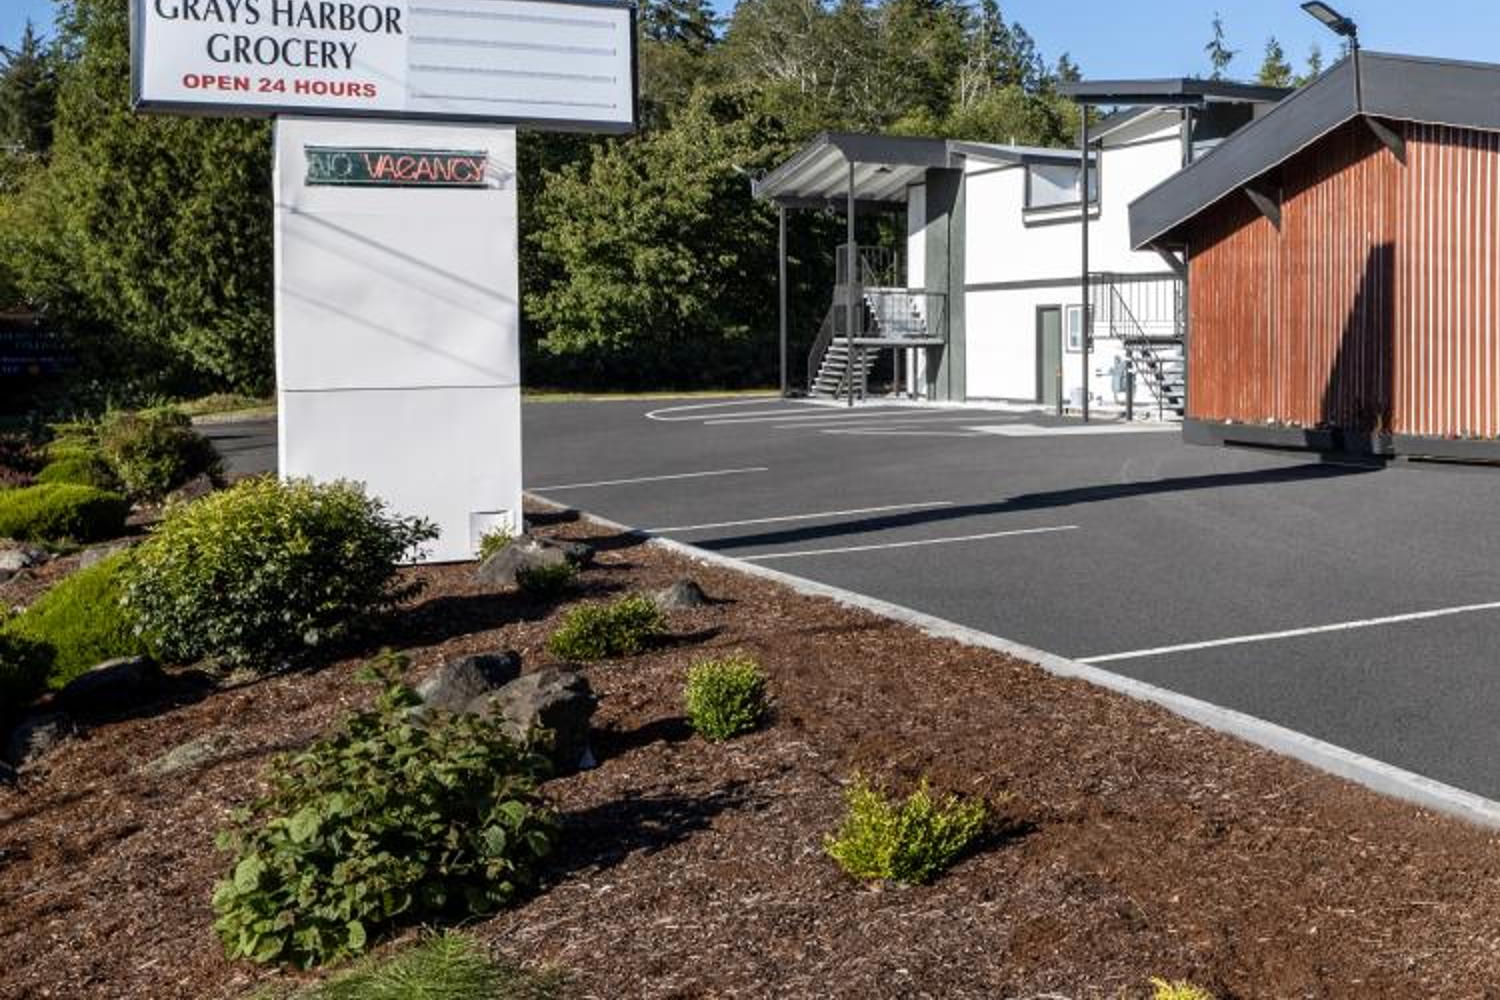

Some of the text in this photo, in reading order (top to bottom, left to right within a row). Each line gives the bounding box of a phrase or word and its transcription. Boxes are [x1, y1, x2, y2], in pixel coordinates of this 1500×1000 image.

[206, 33, 357, 69] GROCERY
[183, 73, 377, 98] OPEN 24 HOURS
[307, 151, 487, 181] NO VACANCY
